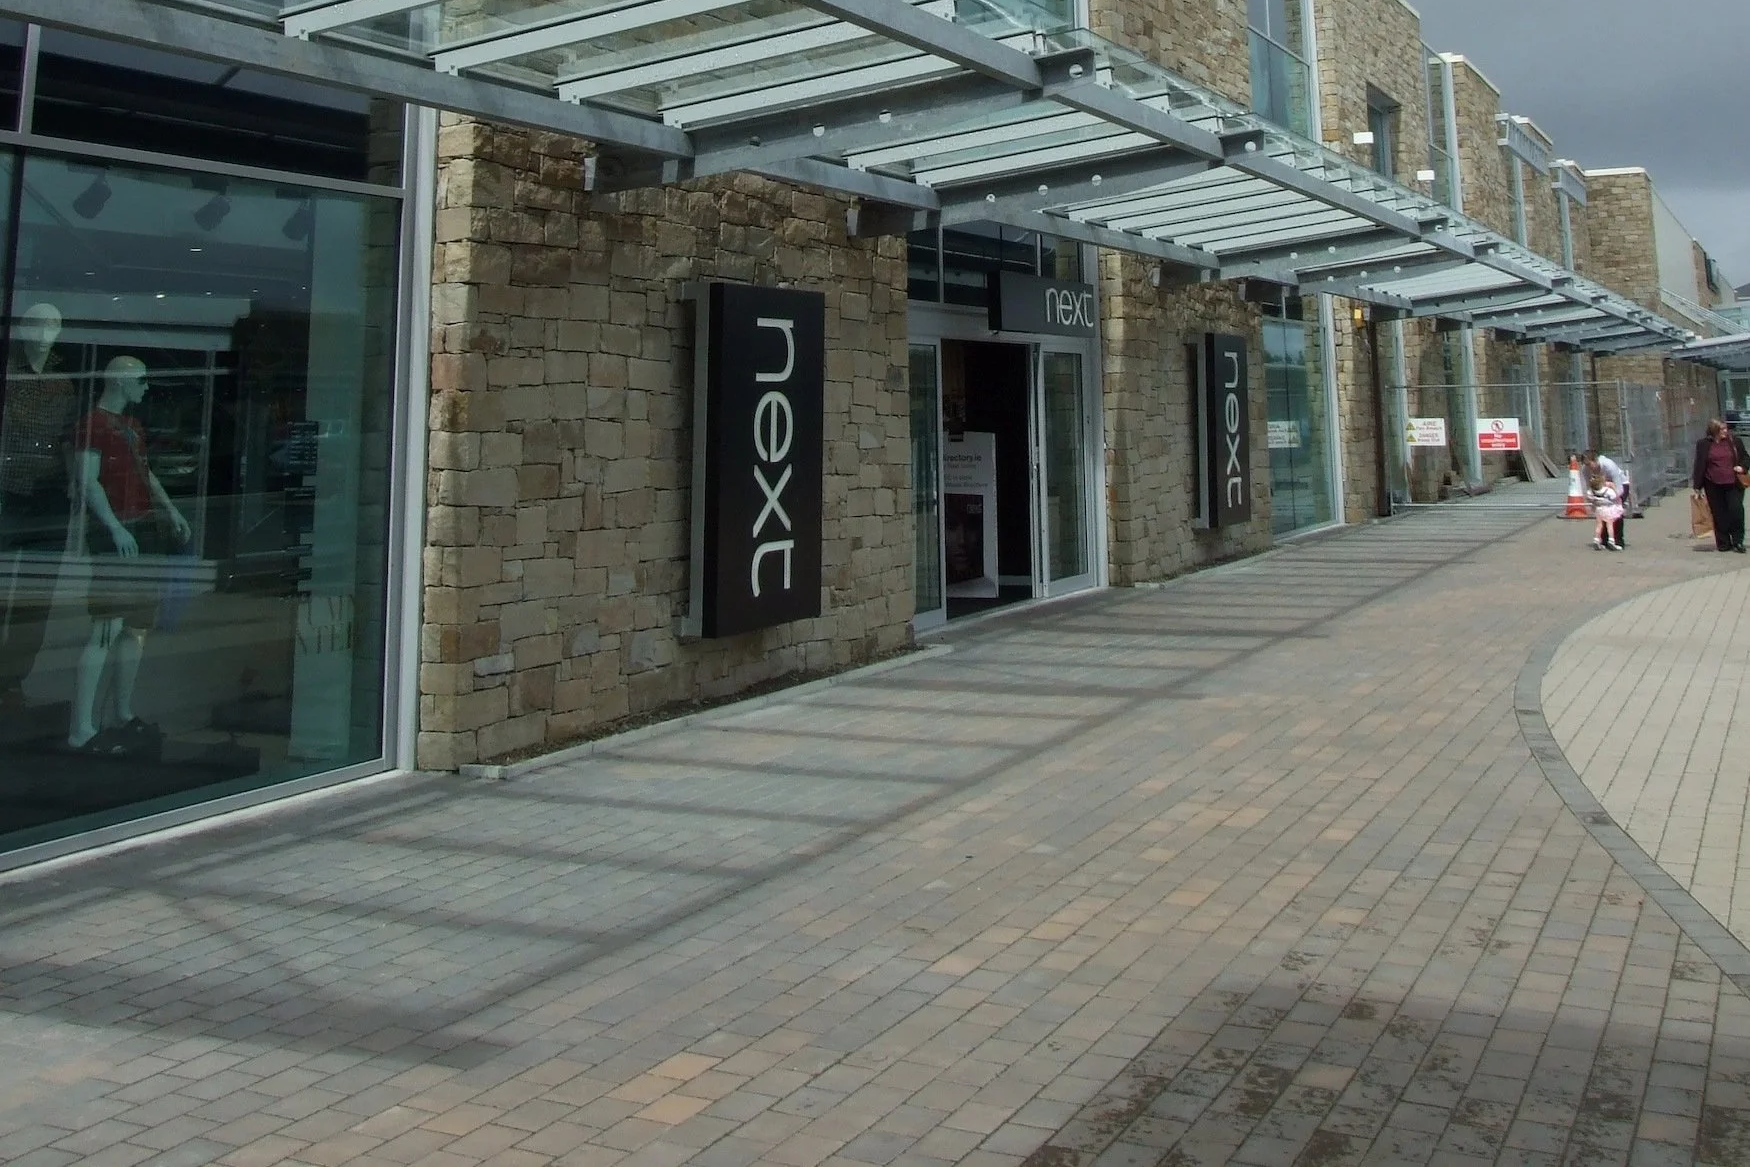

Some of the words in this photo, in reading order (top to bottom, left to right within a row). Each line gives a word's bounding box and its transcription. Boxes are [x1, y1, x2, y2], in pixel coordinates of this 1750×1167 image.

[1045, 288, 1094, 328] next
[751, 317, 795, 597] next
[1224, 351, 1242, 508] next
